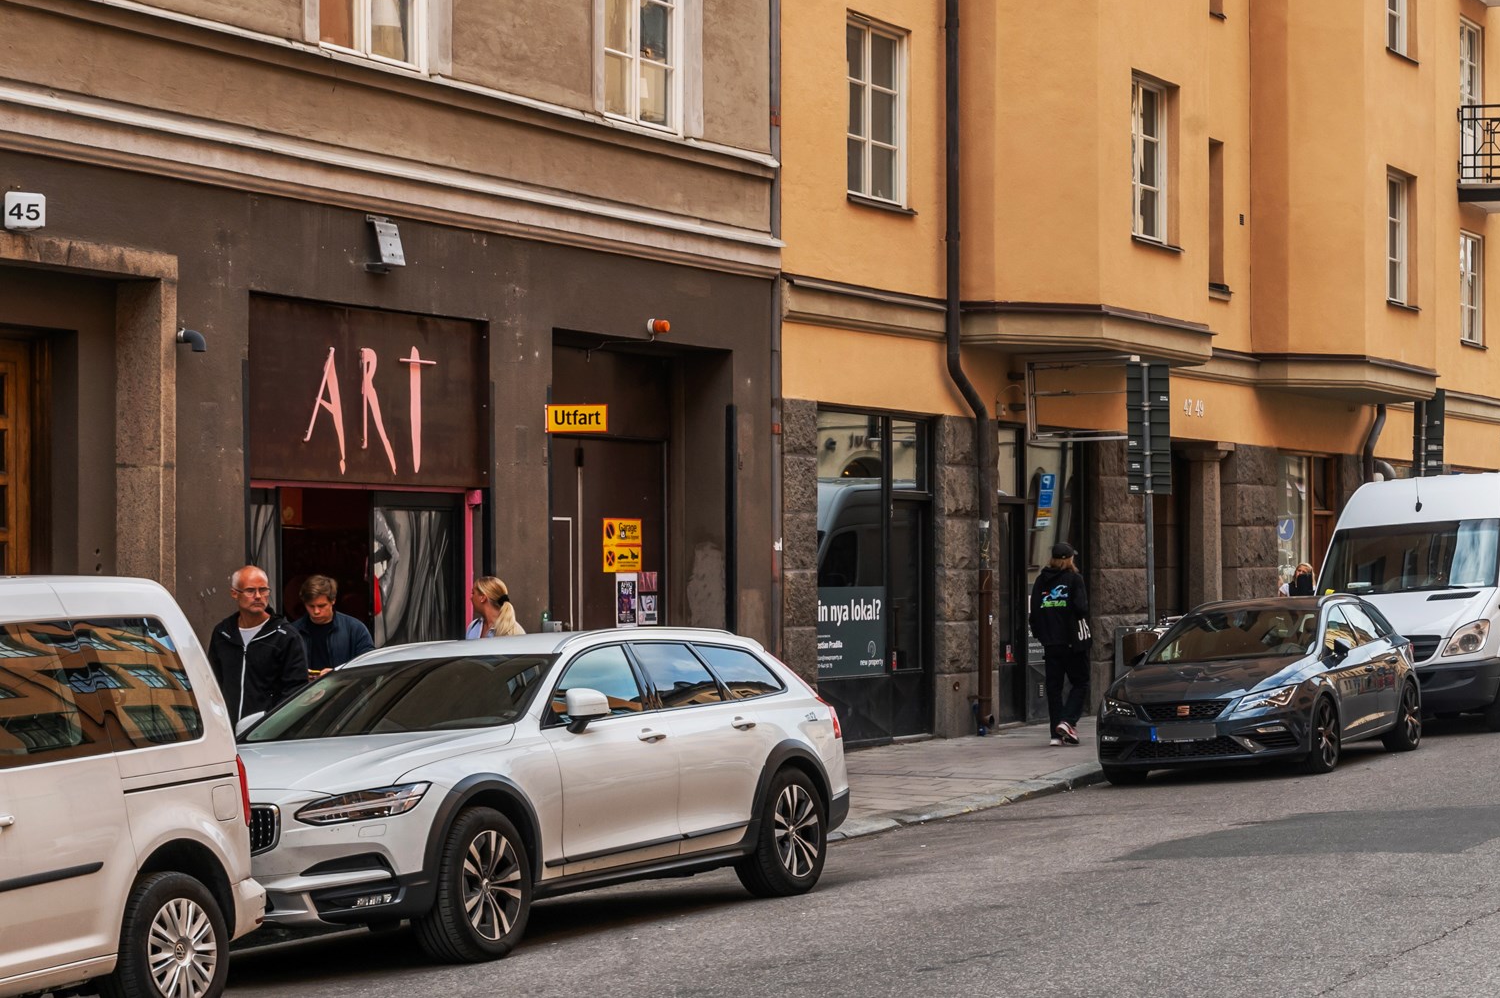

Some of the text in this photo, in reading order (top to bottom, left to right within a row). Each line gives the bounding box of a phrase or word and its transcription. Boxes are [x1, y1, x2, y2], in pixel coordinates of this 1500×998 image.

[9, 203, 40, 221] 45
[303, 346, 437, 475] ART
[554, 410, 601, 425] Utfart
[818, 598, 882, 627] in nya lokal?
[868, 658, 884, 667] property
